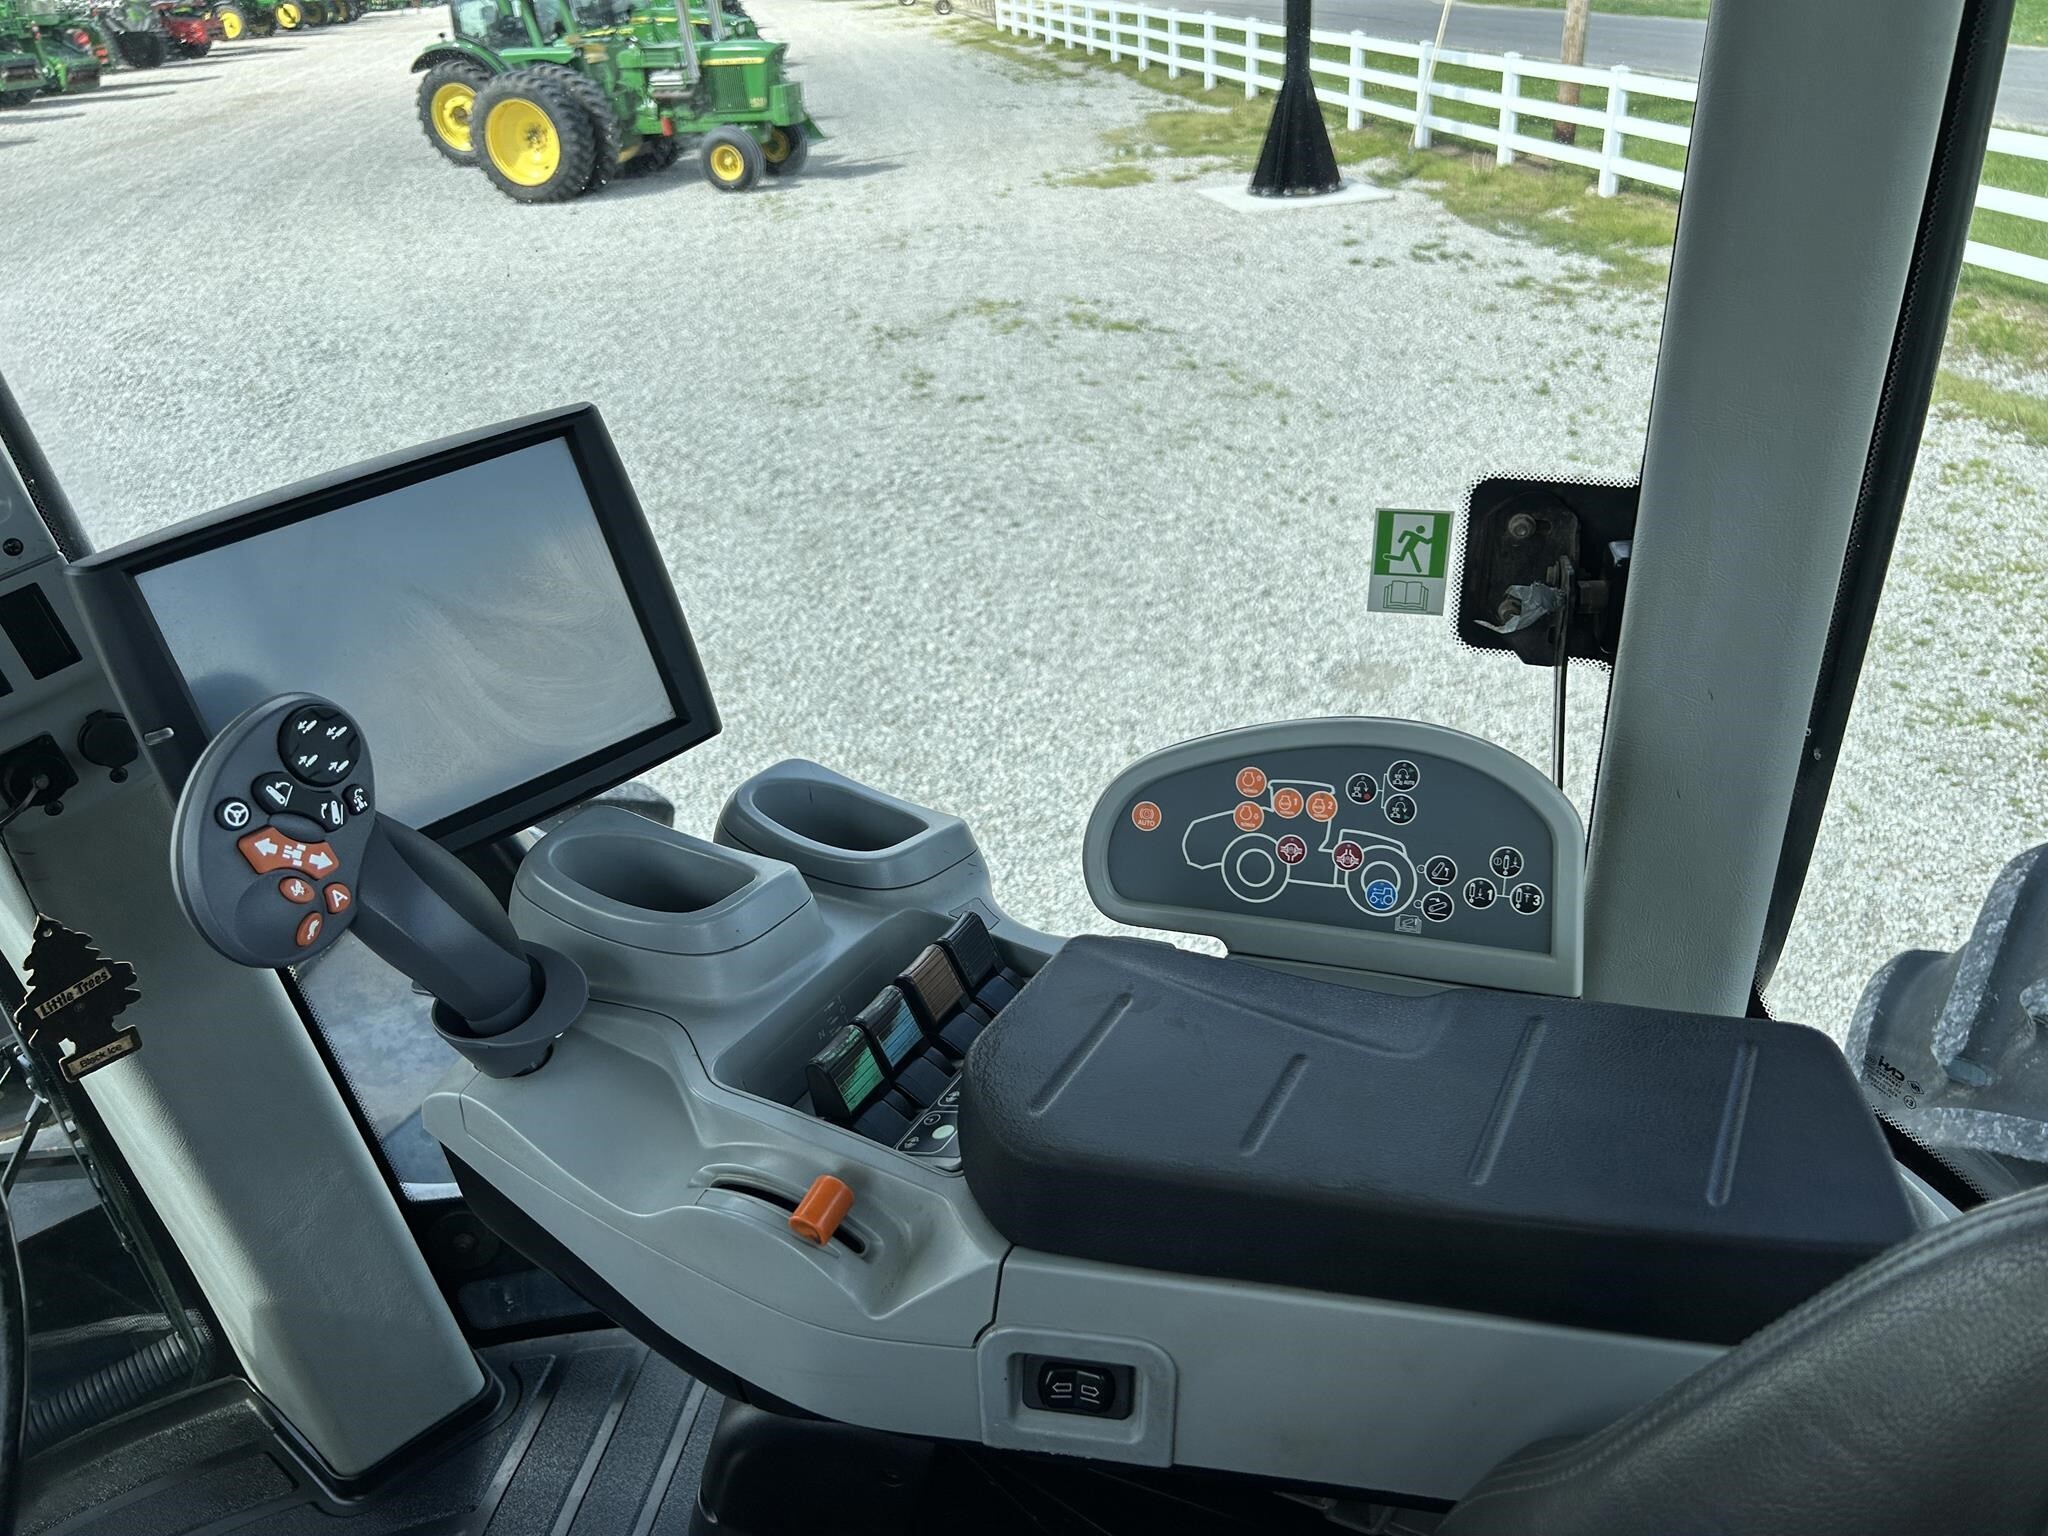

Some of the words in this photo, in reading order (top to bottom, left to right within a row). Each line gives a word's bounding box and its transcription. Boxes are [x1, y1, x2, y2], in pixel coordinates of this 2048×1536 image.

[1137, 819, 1155, 828] AUTO
[331, 888, 349, 908] A
[1486, 889, 1493, 901] 1
[1532, 895, 1541, 906] 3
[39, 990, 74, 1017] Little
[73, 971, 109, 998] Trees
[79, 1050, 107, 1069] Black
[107, 1043, 122, 1057] Ice
